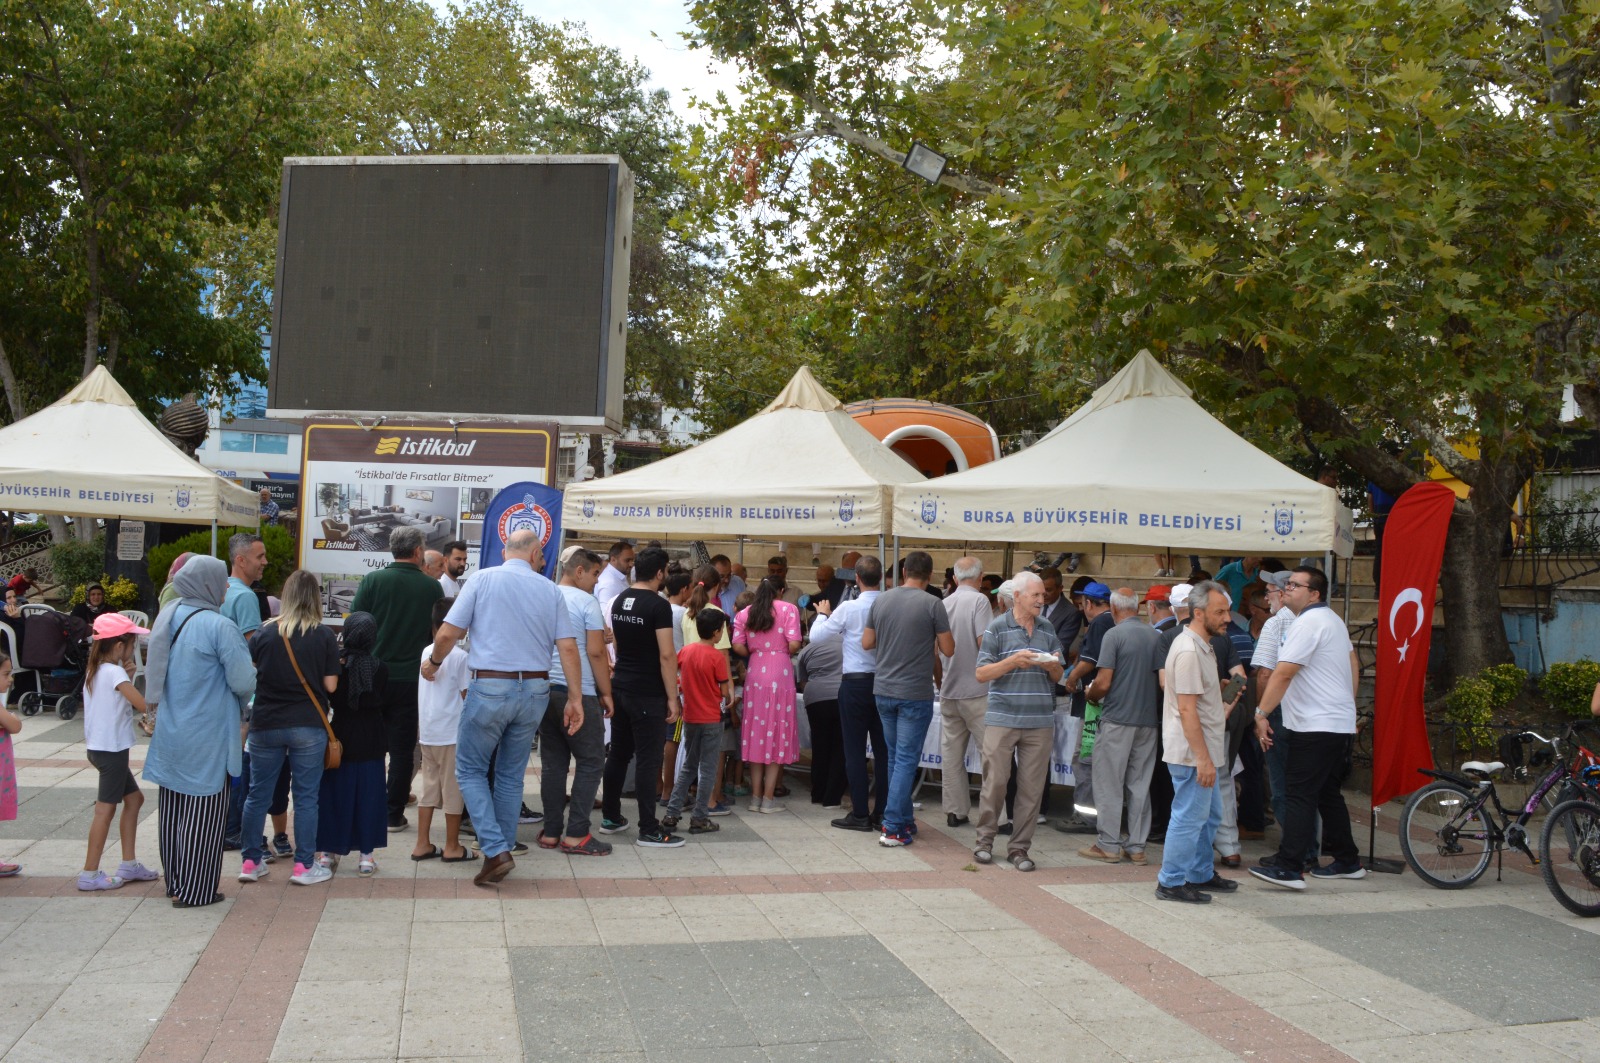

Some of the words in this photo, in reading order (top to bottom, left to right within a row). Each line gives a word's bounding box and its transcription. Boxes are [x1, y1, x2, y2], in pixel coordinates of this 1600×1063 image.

[400, 436, 477, 457] istikbal
[410, 471, 452, 482] Fırsatlar
[453, 473, 494, 483] Bitmez"
[78, 489, 154, 504] BELEDİYESİ
[613, 505, 651, 518] BURSA
[657, 504, 733, 520] BÜYÜKŞEHİR
[740, 505, 815, 519] BELEDİYESİ
[963, 510, 1015, 524] BURSA
[1023, 507, 1129, 526] BÜYÜKŞEHİR
[1138, 513, 1242, 531] BELEDİYESİ
[325, 540, 357, 550] istikbal
